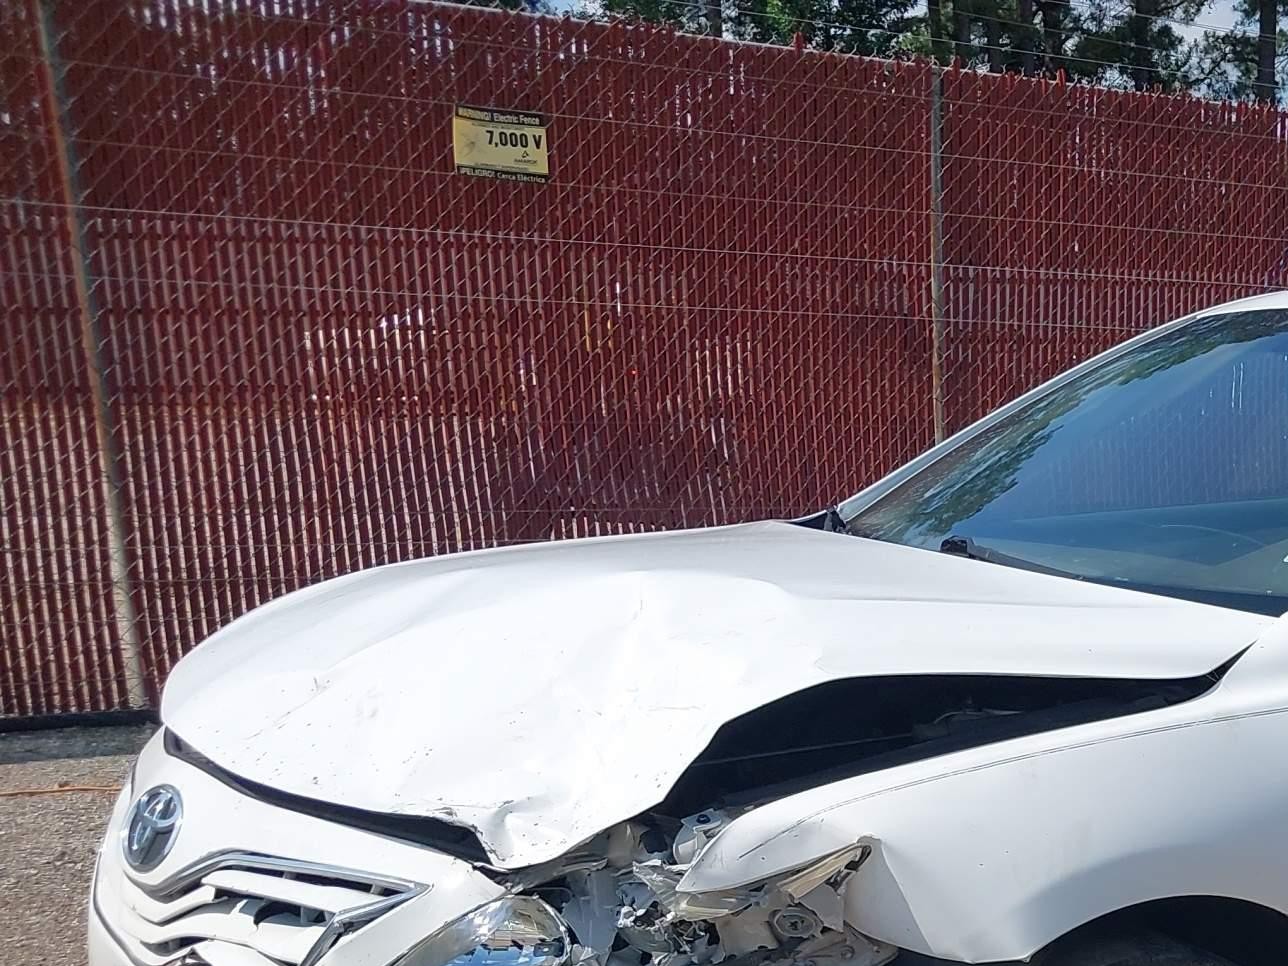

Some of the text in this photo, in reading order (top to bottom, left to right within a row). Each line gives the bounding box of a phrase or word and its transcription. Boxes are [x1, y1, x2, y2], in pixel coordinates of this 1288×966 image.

[493, 113, 519, 123] Electric
[520, 115, 540, 125] Fence
[486, 130, 543, 150] 7,000 V
[497, 172, 516, 180] Cerca
